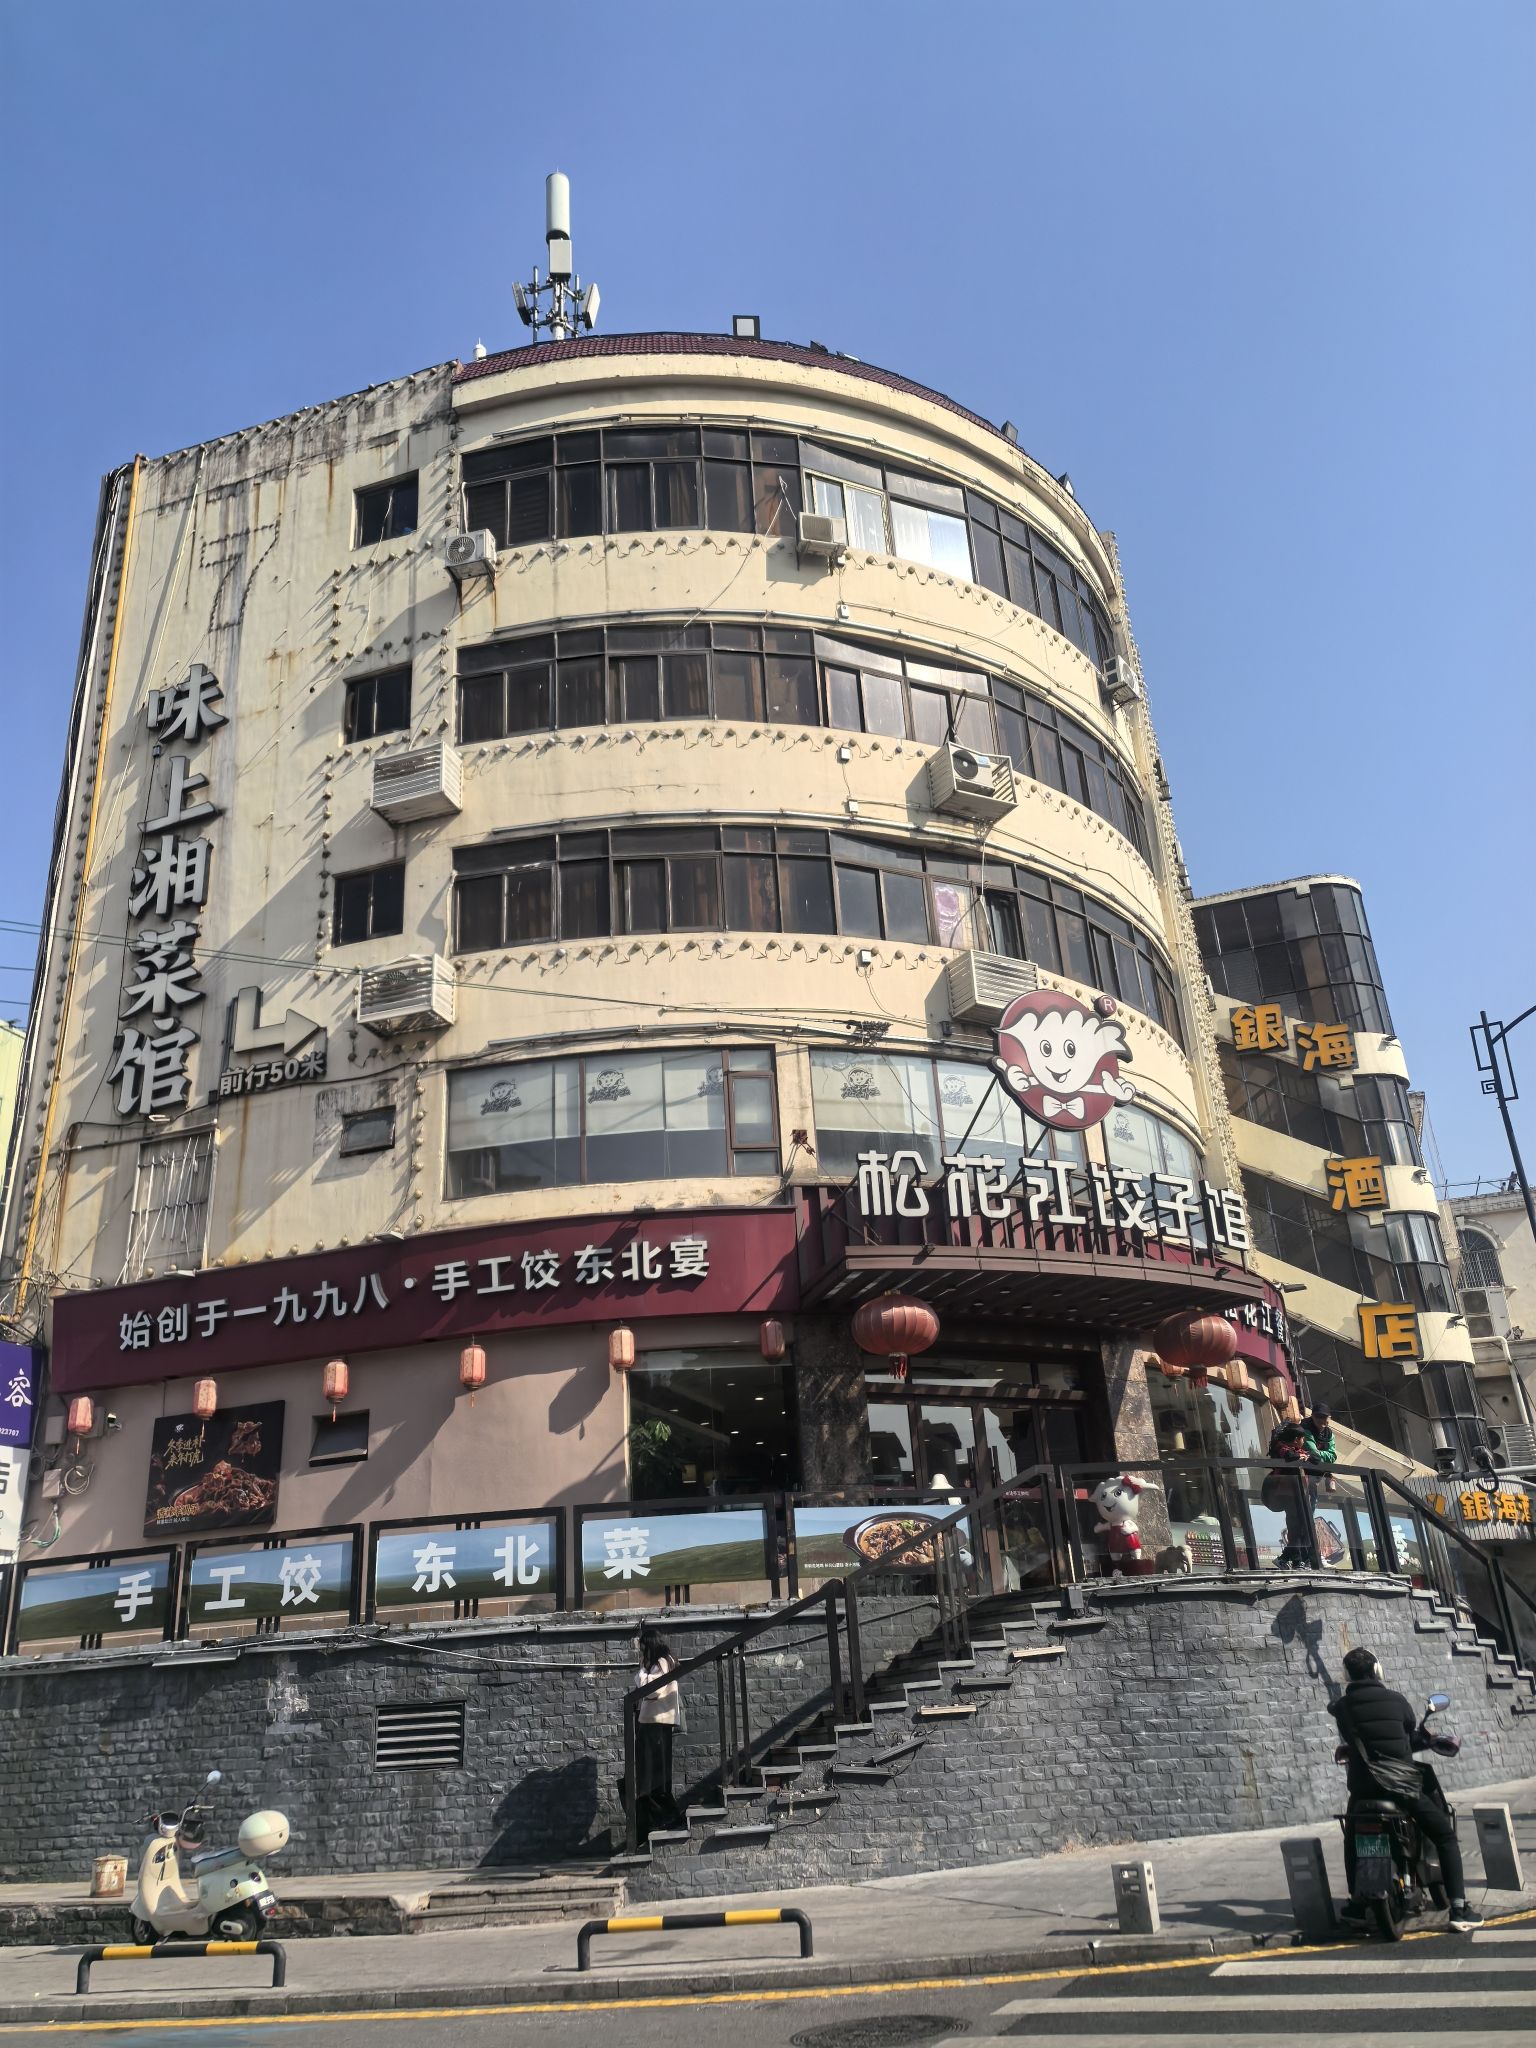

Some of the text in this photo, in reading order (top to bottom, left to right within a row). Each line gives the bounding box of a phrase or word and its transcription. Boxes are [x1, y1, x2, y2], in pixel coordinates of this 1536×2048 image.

[107, 663, 229, 1116] 味上湘菜馆
[220, 1053, 326, 1097] 前行50米
[856, 1150, 1250, 1250] 松花江饺子馆
